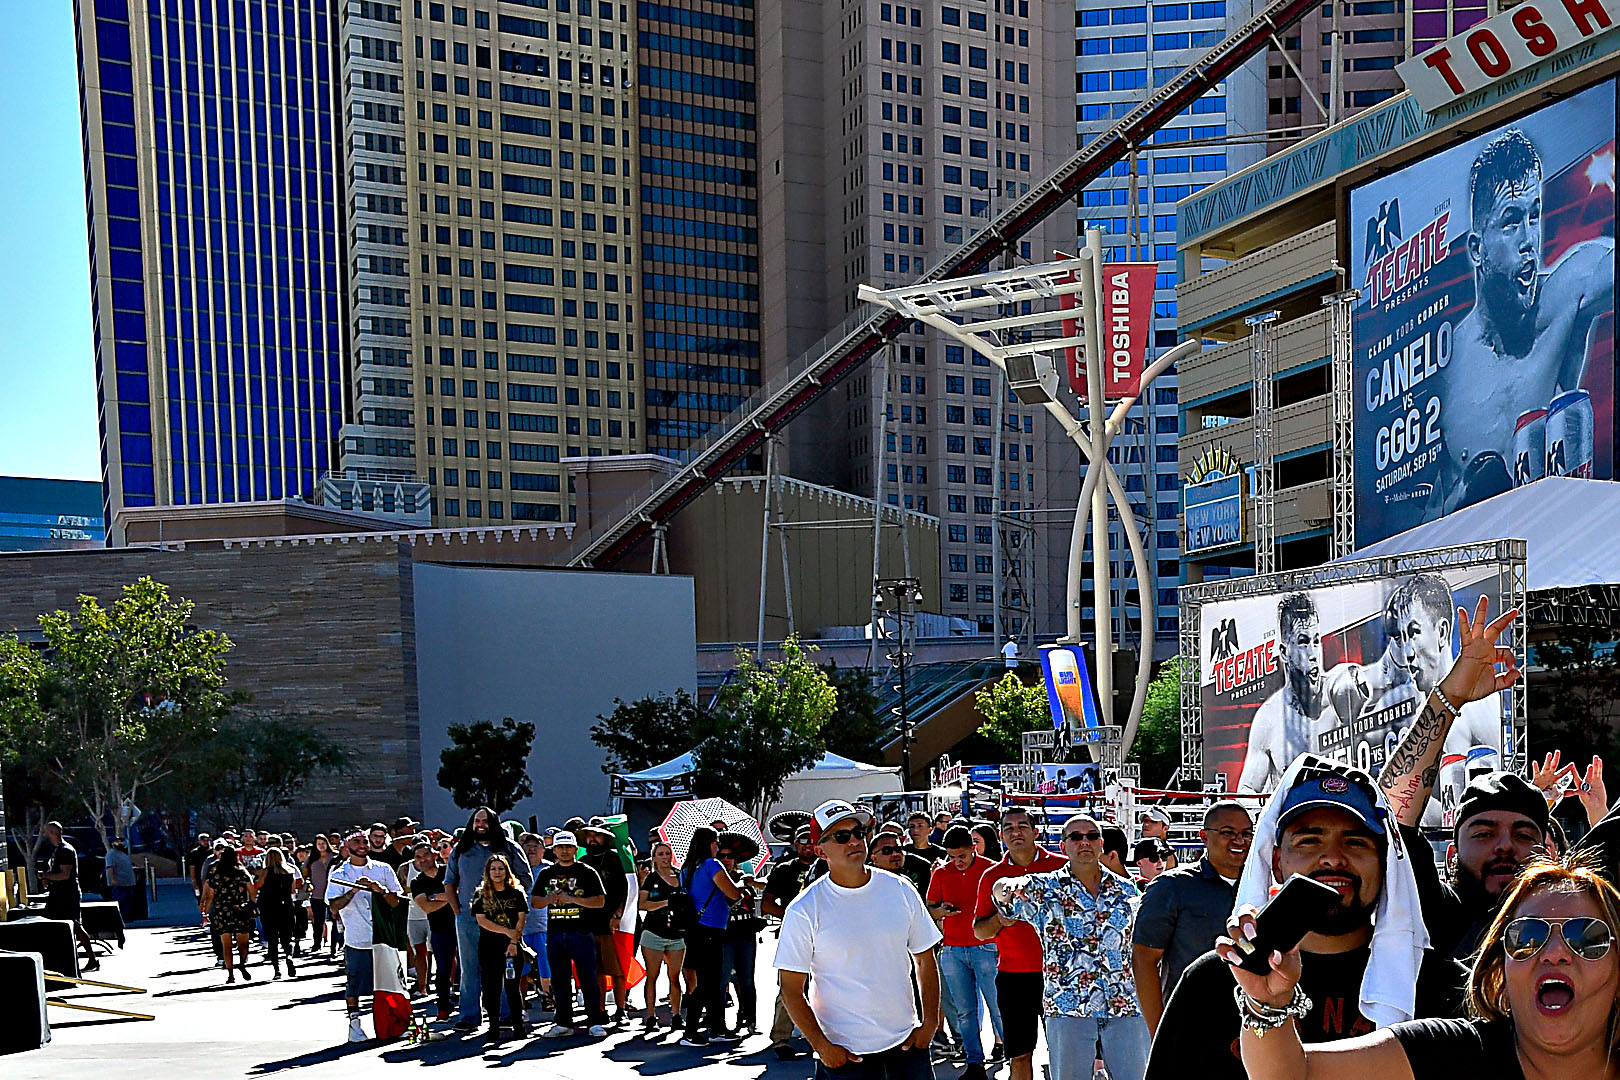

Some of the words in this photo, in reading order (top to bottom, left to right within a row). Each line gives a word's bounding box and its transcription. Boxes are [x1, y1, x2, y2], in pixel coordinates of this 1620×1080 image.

[1363, 210, 1450, 309] TECATE
[1385, 276, 1429, 312] PRESENTS
[1111, 271, 1131, 383] TOSHIBA
[1368, 333, 1392, 360] CLAIM
[1395, 318, 1414, 341] YOUR
[1417, 294, 1449, 325] CORNER
[1366, 321, 1453, 412] CANELO
[1376, 408, 1420, 471] GGG
[1425, 396, 1441, 445] 2
[1376, 460, 1413, 494] SATURDAY,
[1413, 452, 1427, 473] SEP
[1428, 442, 1442, 464] 15TH
[1188, 526, 1210, 549] NEW
[1211, 521, 1237, 543] YORK
[1189, 508, 1209, 526] NEW
[1212, 501, 1237, 520] YORK
[1210, 639, 1277, 696] TECATE
[1230, 681, 1265, 700] PRESENTS
[1322, 725, 1350, 747] CLAIM
[1353, 716, 1374, 735] YOUR
[1377, 701, 1413, 726] CORNER
